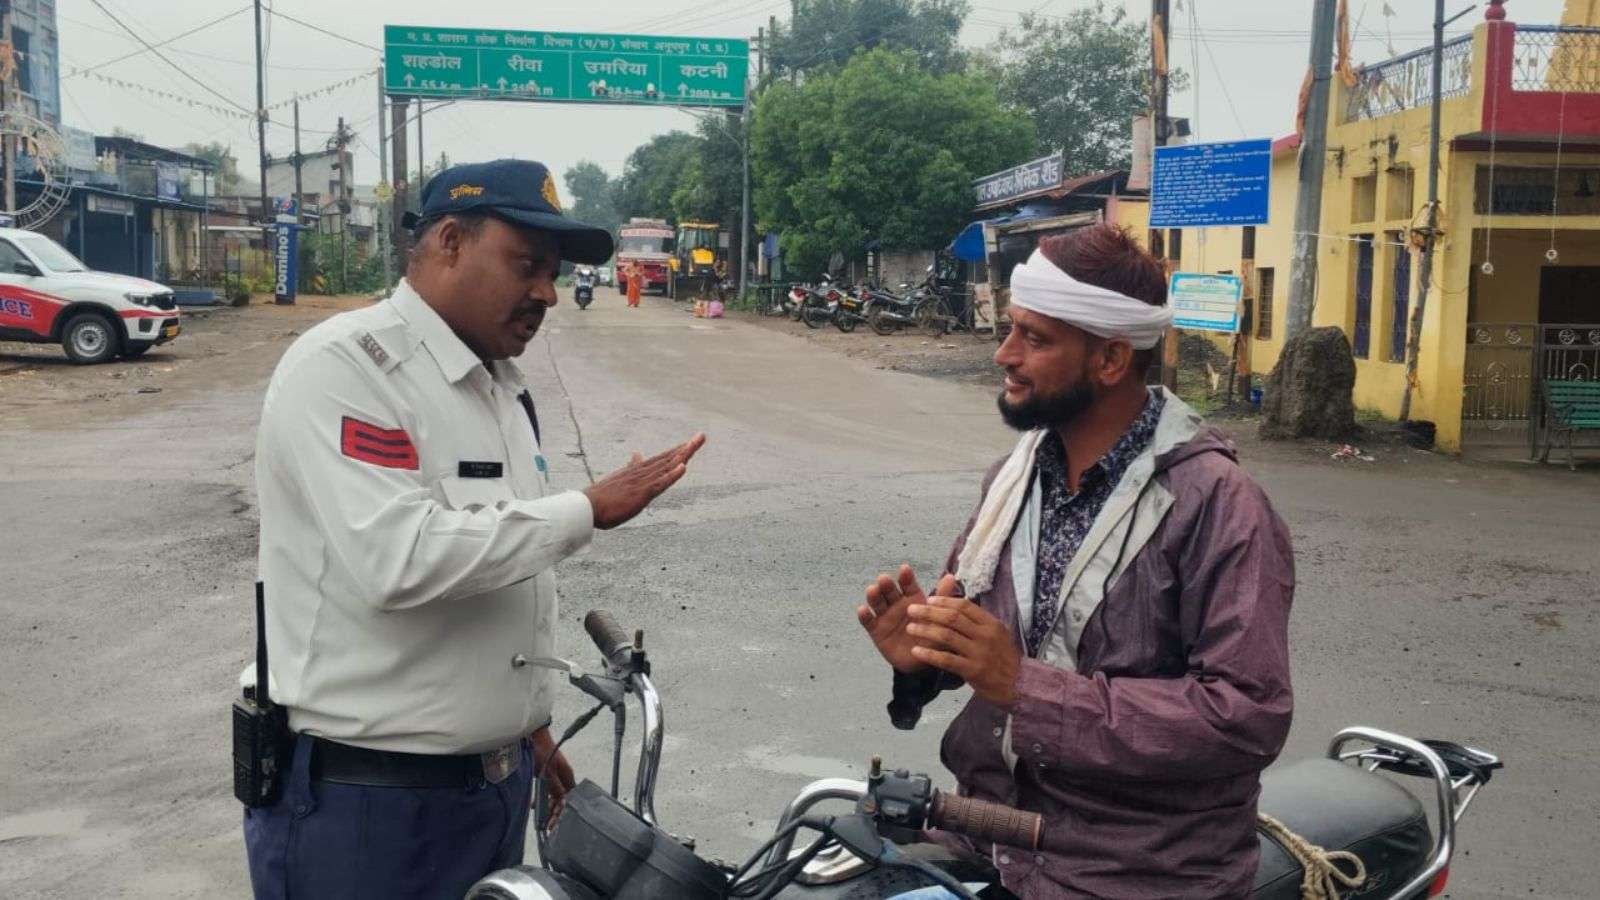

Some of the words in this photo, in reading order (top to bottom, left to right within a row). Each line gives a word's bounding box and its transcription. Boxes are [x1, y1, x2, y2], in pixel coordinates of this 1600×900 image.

[402, 52, 462, 70] शहडोल
[507, 54, 543, 72] रीवा
[584, 58, 648, 76] उमरिया
[679, 61, 728, 79] कटनी
[449, 184, 485, 200] पुलिस
